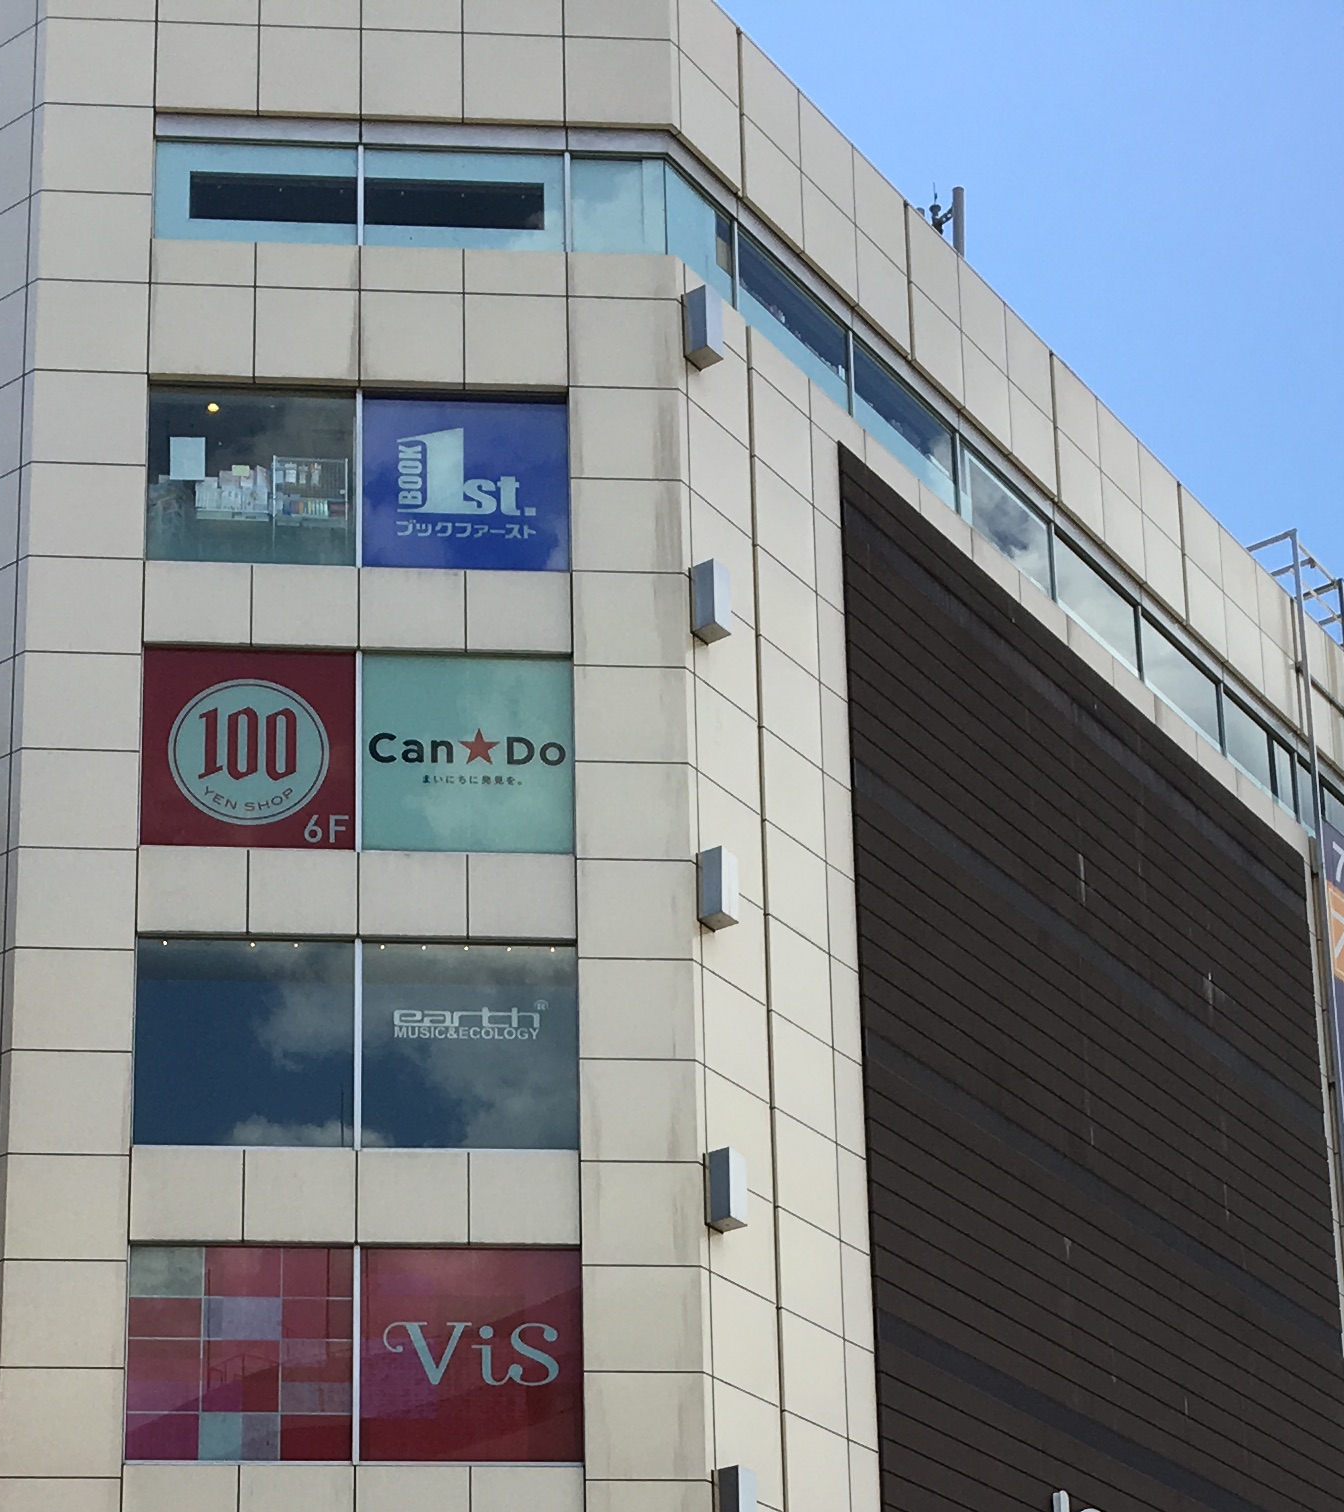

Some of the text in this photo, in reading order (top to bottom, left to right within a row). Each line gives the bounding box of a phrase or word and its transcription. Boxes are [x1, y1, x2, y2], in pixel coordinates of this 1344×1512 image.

[397, 444, 423, 505] BOOK
[395, 518, 537, 540] ブックファースト
[198, 706, 299, 781] 100
[367, 732, 568, 768] Can Do
[421, 772, 525, 787] まいにちに発見を。
[202, 784, 296, 814] YEN SHOP
[302, 814, 350, 845] 6F
[392, 1005, 541, 1028] earth
[393, 1026, 541, 1041] MUSIC&ECOLOGY
[382, 1320, 562, 1388] ViS
